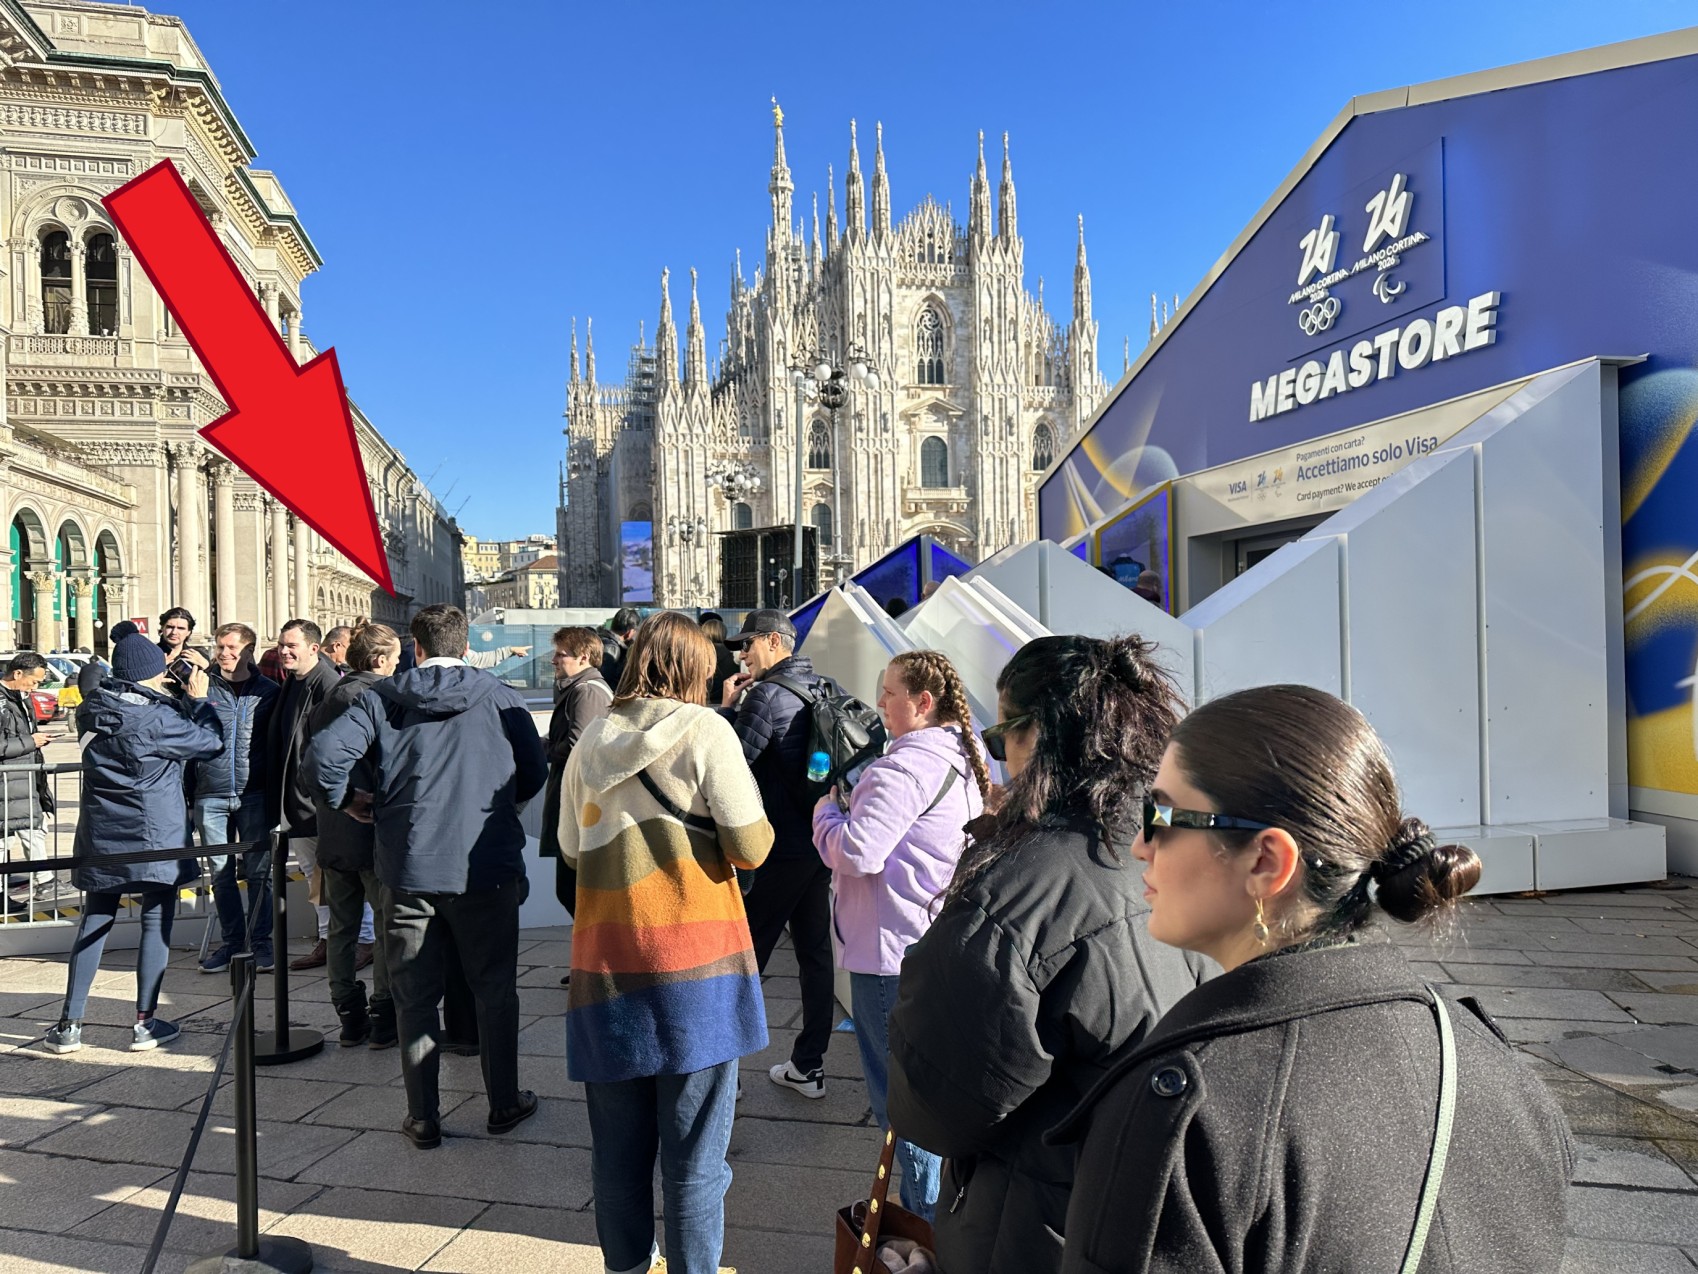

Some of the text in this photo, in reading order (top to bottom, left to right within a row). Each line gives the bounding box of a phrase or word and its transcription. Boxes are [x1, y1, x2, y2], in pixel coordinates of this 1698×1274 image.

[1351, 231, 1427, 274] MILANO CORTINA
[1377, 255, 1397, 272] 2026
[1288, 268, 1350, 304] MILANO CORTINA
[1310, 289, 1326, 303] 2026
[1249, 291, 1501, 423] MEGASTORE
[1296, 435, 1366, 462] Pagamenti con carta?
[1296, 453, 1370, 482] Accettiamo
[1372, 442, 1403, 465] solo
[1405, 435, 1438, 456] Visa
[1229, 480, 1247, 495] VISA
[1296, 490, 1312, 502] Card
[1312, 483, 1345, 501] payment?
[1345, 481, 1357, 492] We
[1357, 476, 1381, 491] accept
